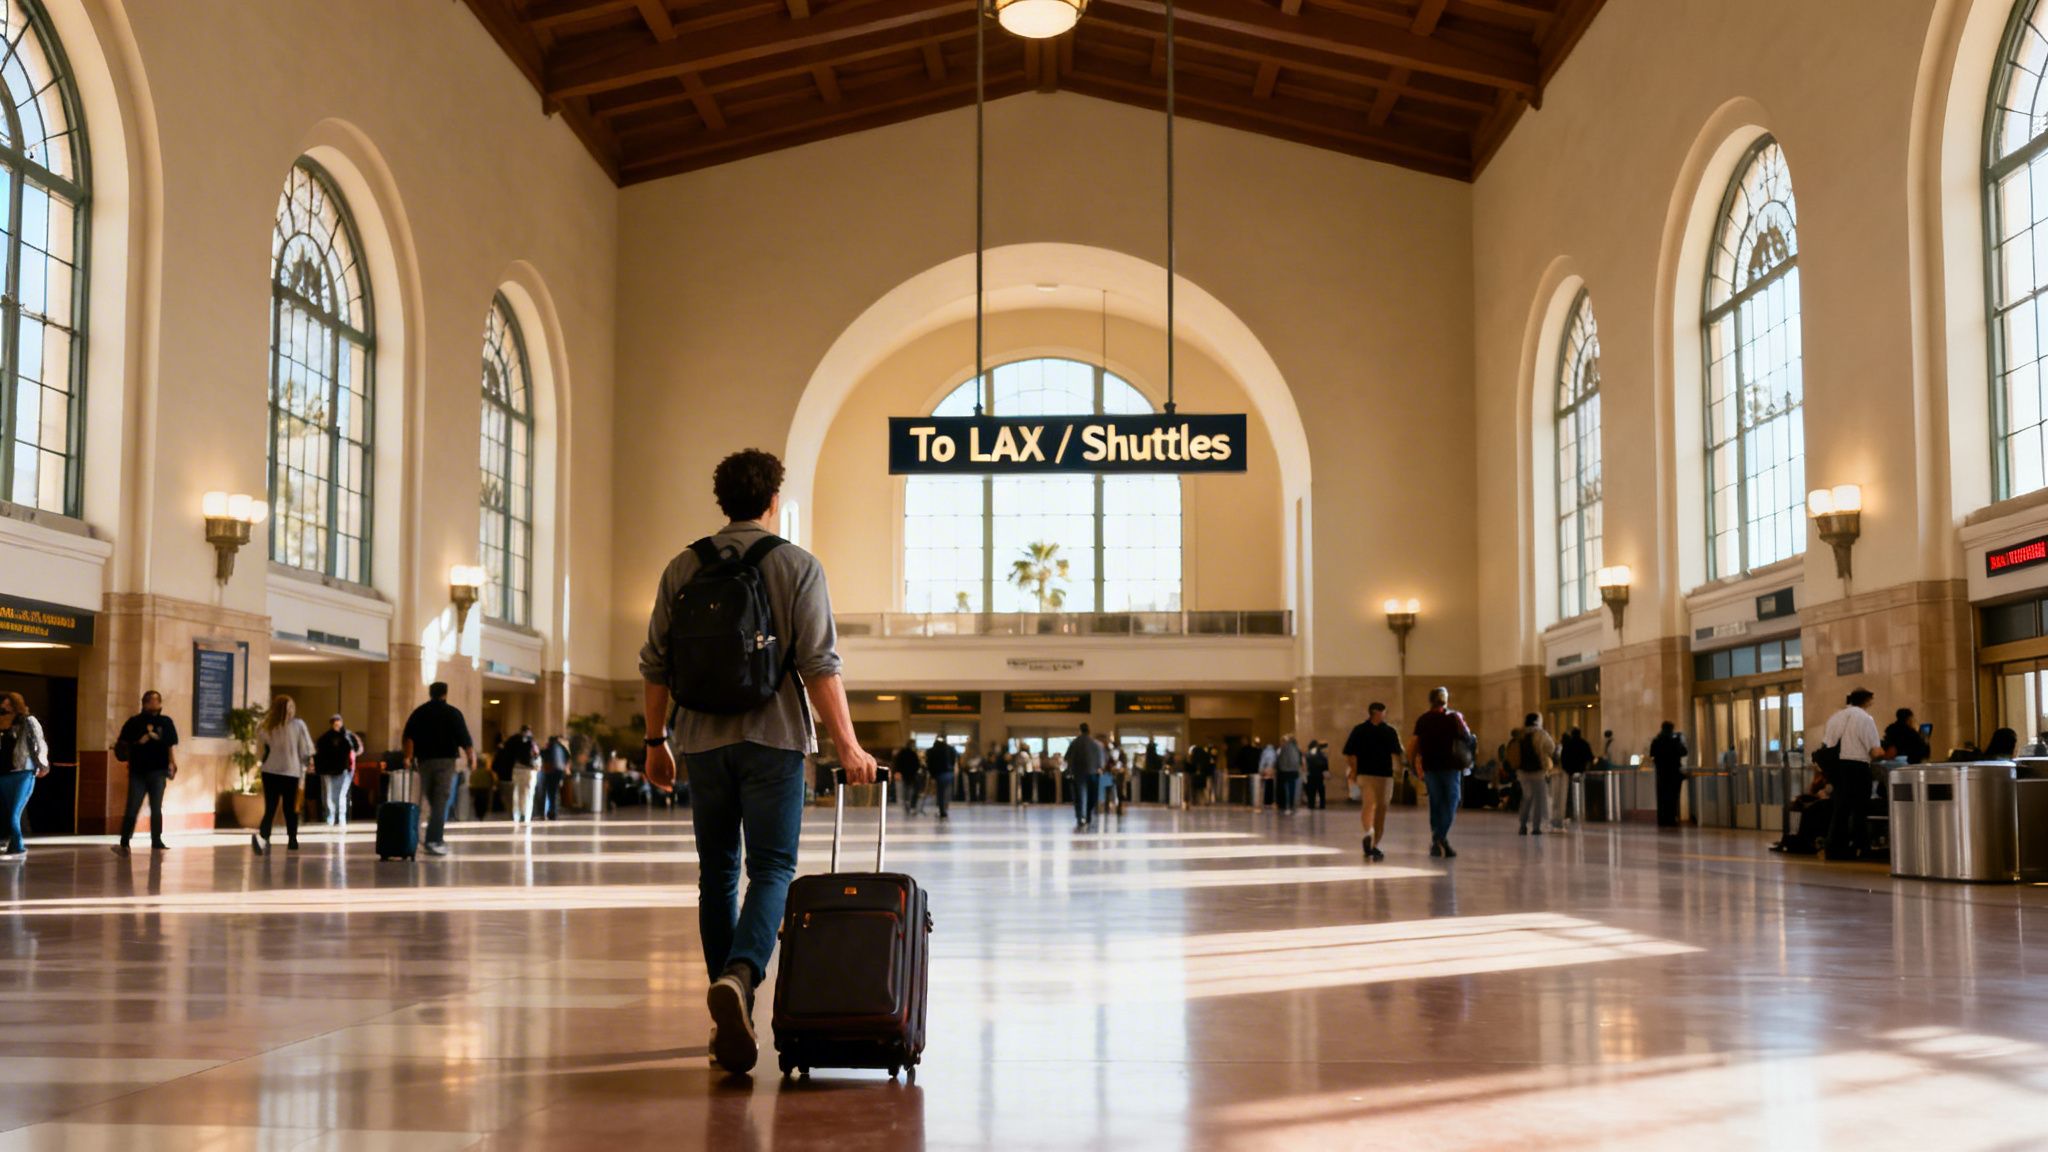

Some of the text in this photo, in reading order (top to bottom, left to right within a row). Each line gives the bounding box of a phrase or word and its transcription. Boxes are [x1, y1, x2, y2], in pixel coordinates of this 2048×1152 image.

[910, 424, 1231, 463] To LAX / Shuttles
